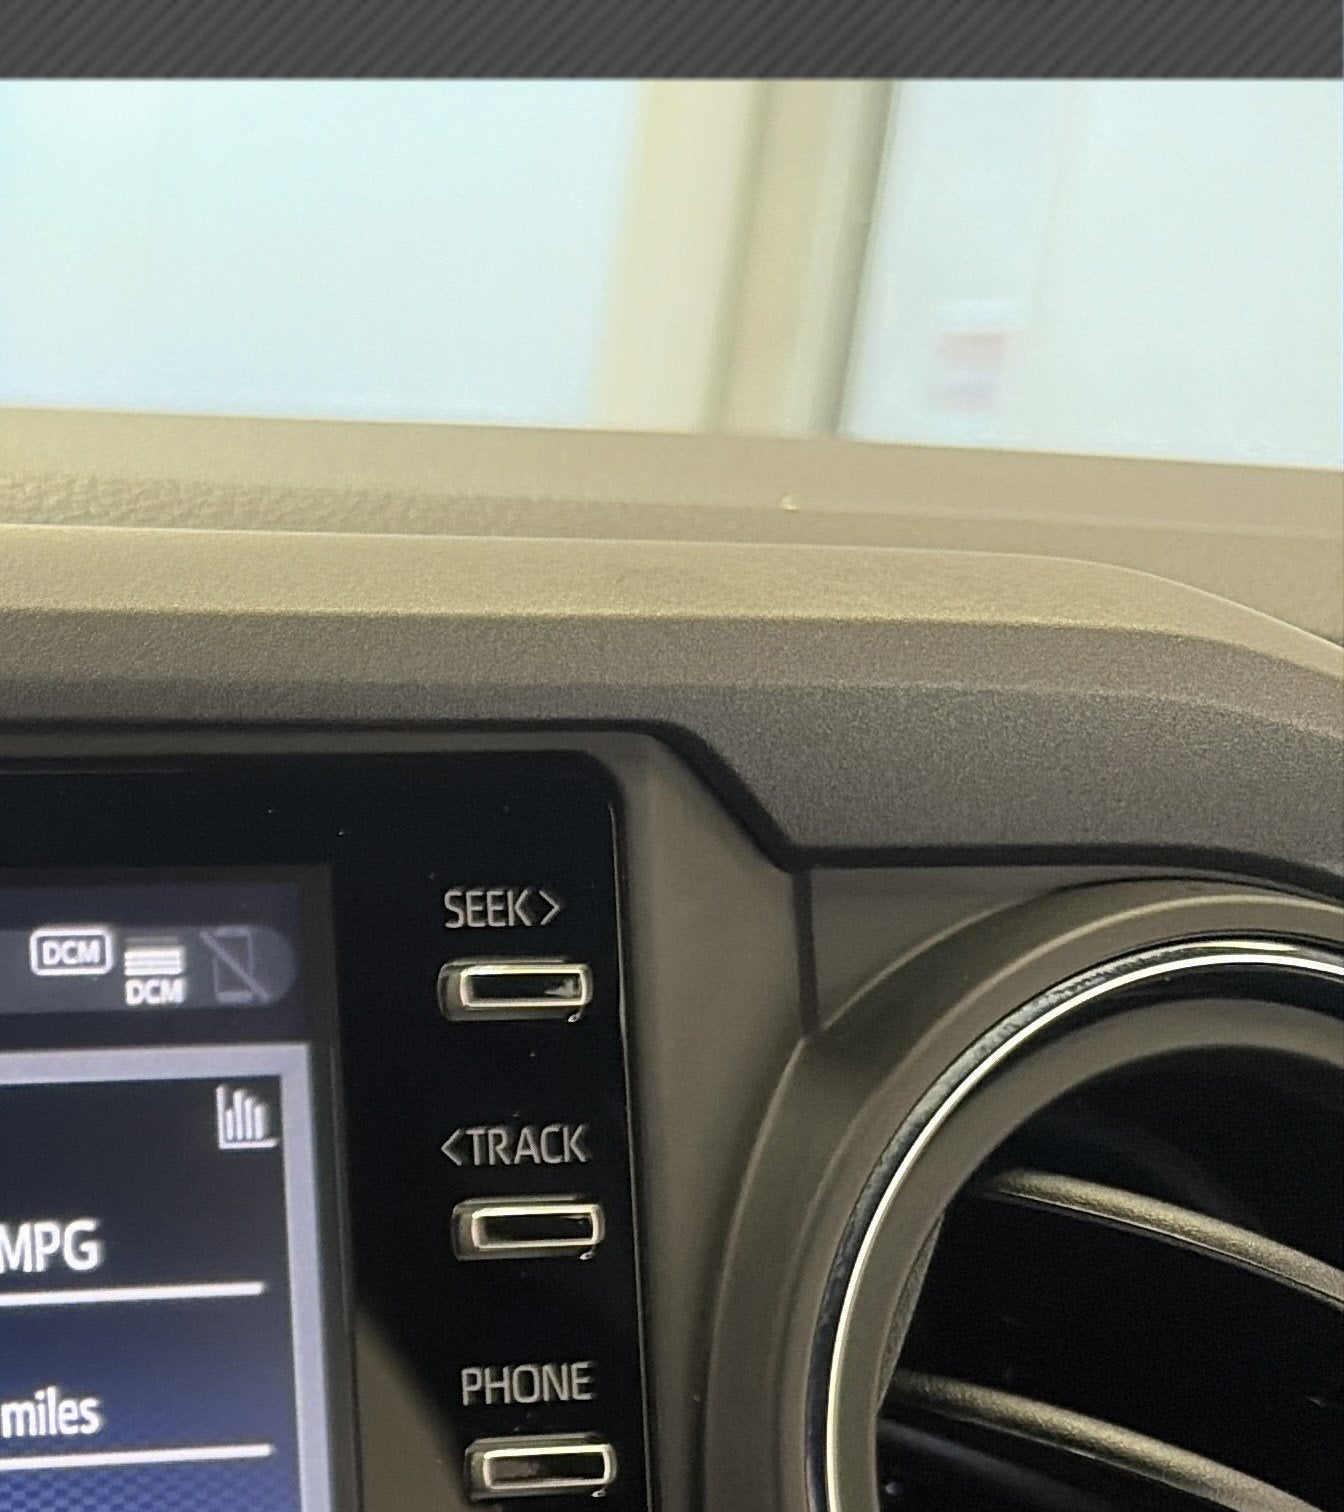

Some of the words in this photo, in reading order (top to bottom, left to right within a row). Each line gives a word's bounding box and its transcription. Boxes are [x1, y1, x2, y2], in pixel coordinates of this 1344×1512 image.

[40, 938, 102, 968] DCM
[124, 976, 185, 1005] DCM
[461, 1361, 595, 1406] PHONE
[0, 1388, 102, 1440] miles
